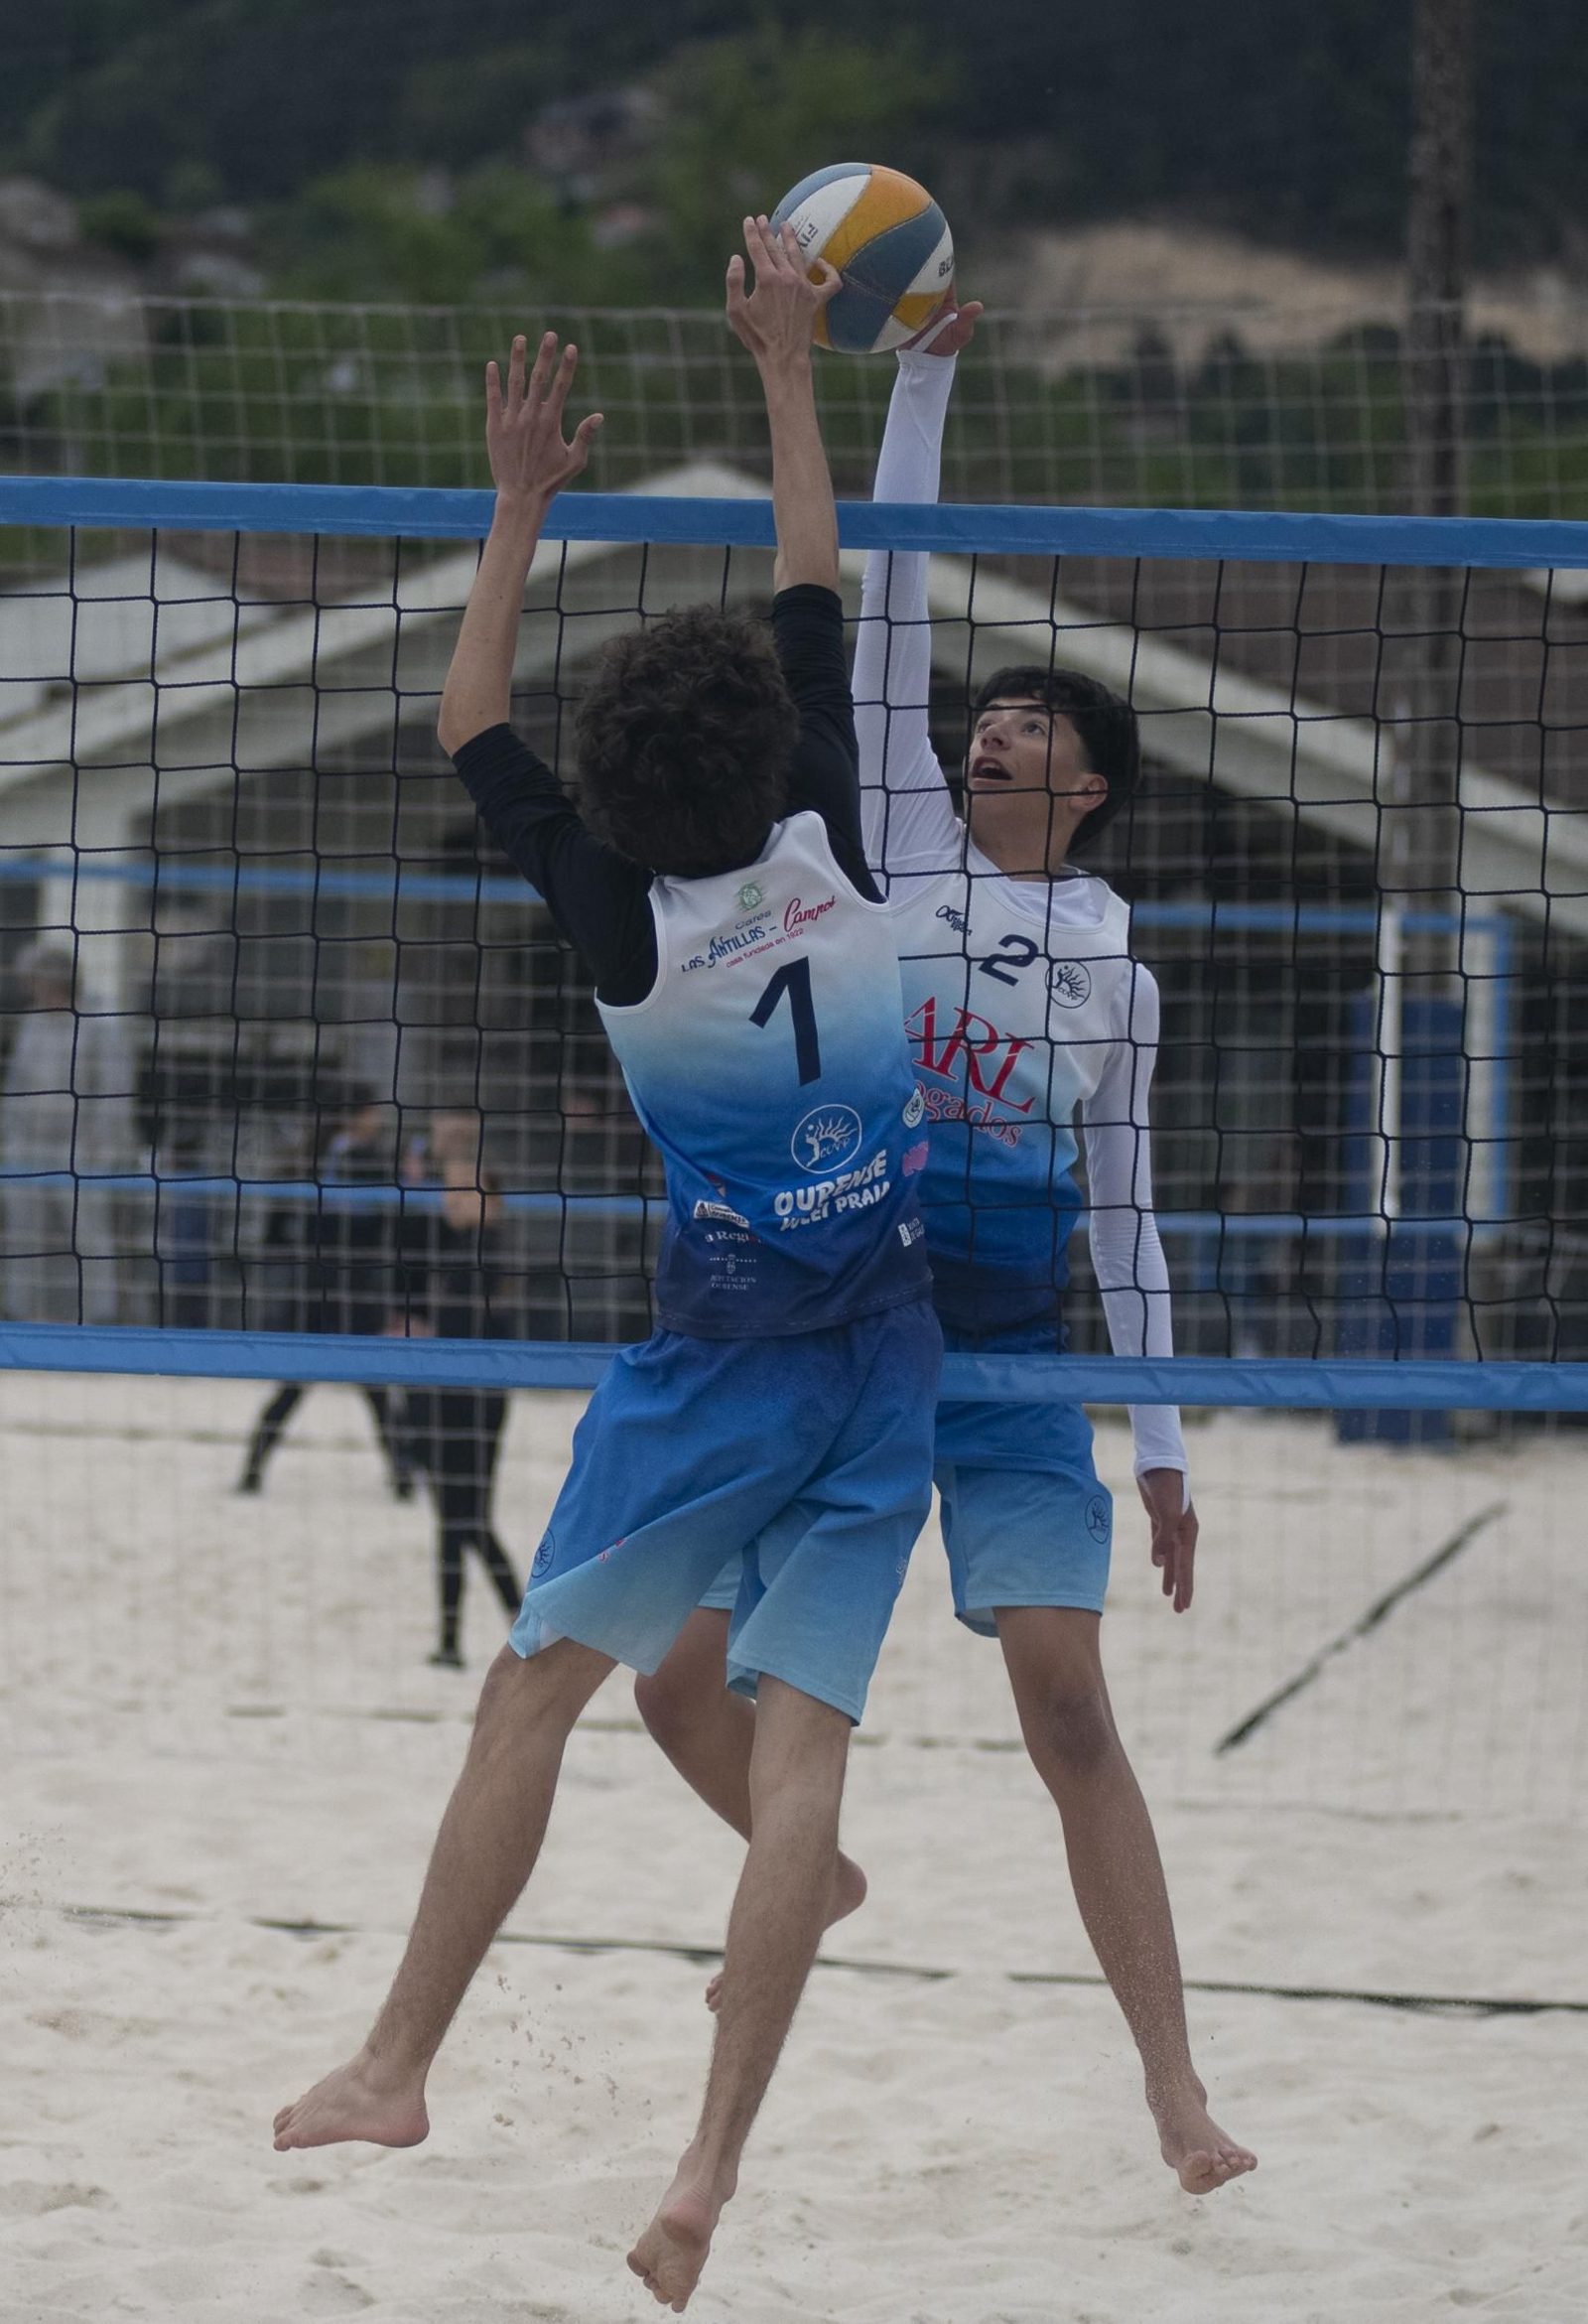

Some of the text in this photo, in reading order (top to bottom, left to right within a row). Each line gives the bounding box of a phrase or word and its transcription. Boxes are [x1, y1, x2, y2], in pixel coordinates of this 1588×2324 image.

[681, 955, 706, 973] LAS
[978, 933, 1039, 987] 2
[747, 955, 822, 1087] 1
